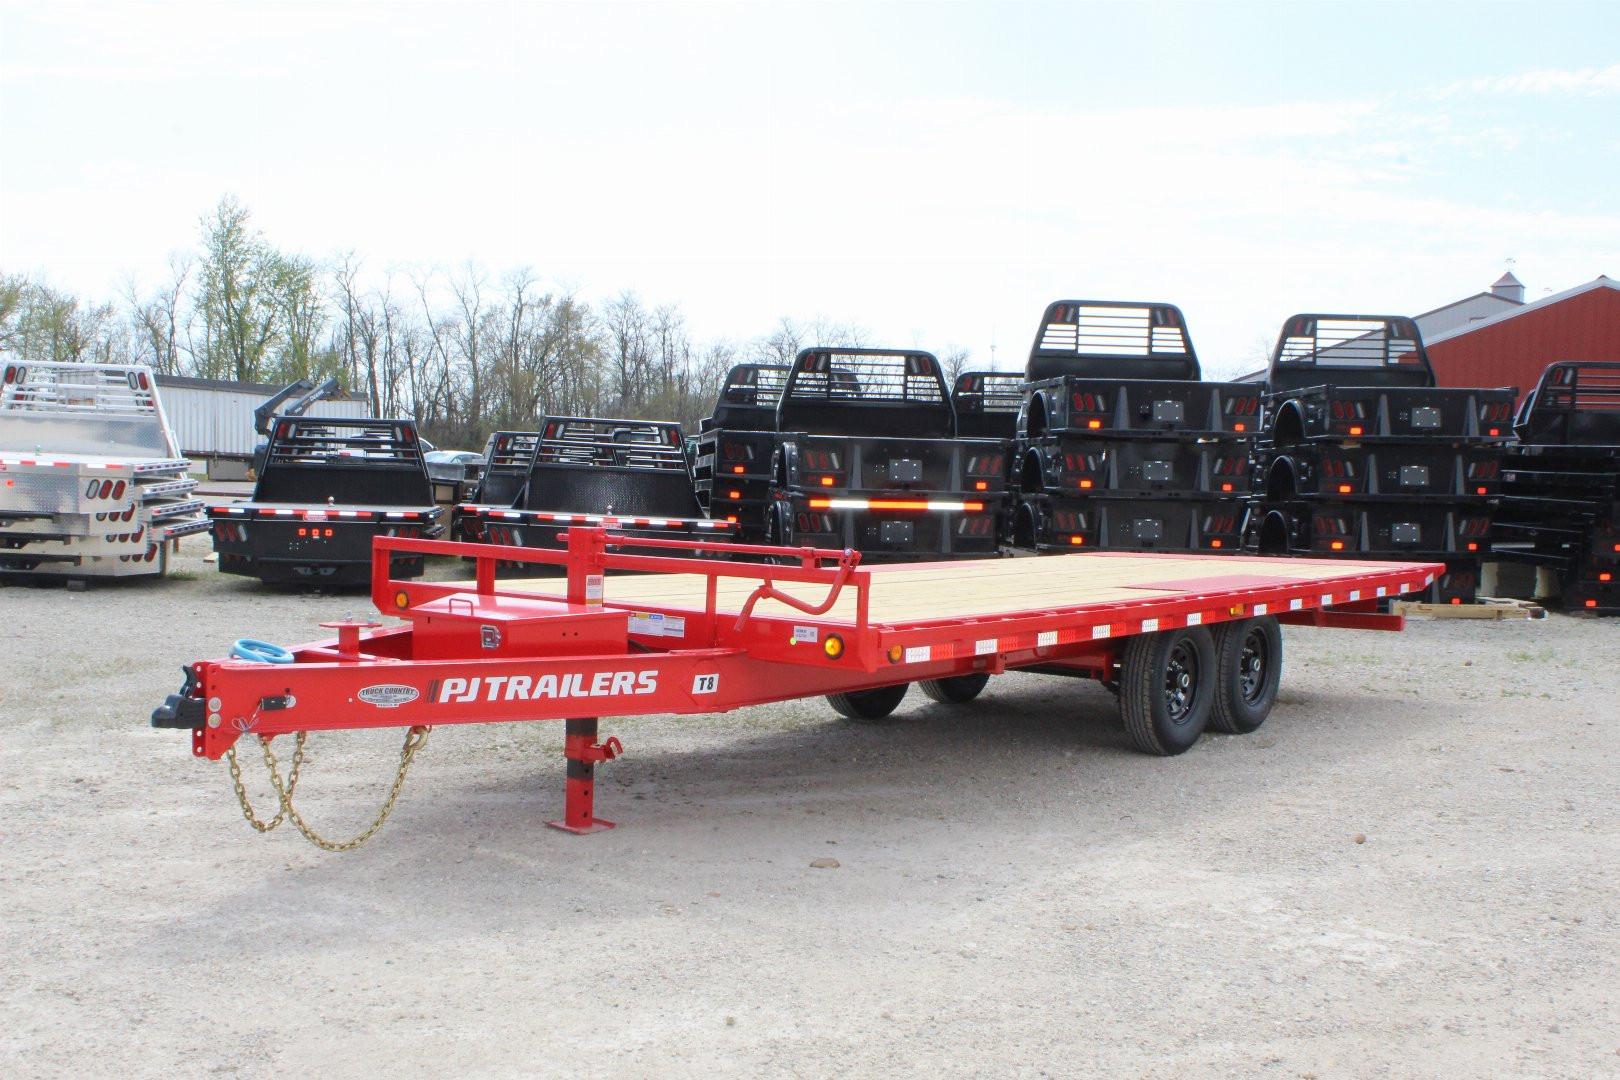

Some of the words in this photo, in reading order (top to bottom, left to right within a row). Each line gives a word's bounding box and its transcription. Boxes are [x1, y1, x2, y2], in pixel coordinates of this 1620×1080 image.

[438, 678, 481, 703] PJ
[484, 670, 659, 701] TRAILERS
[699, 676, 715, 691] T8
[361, 687, 384, 696] TRUCK
[384, 687, 414, 695] COUNTRY
